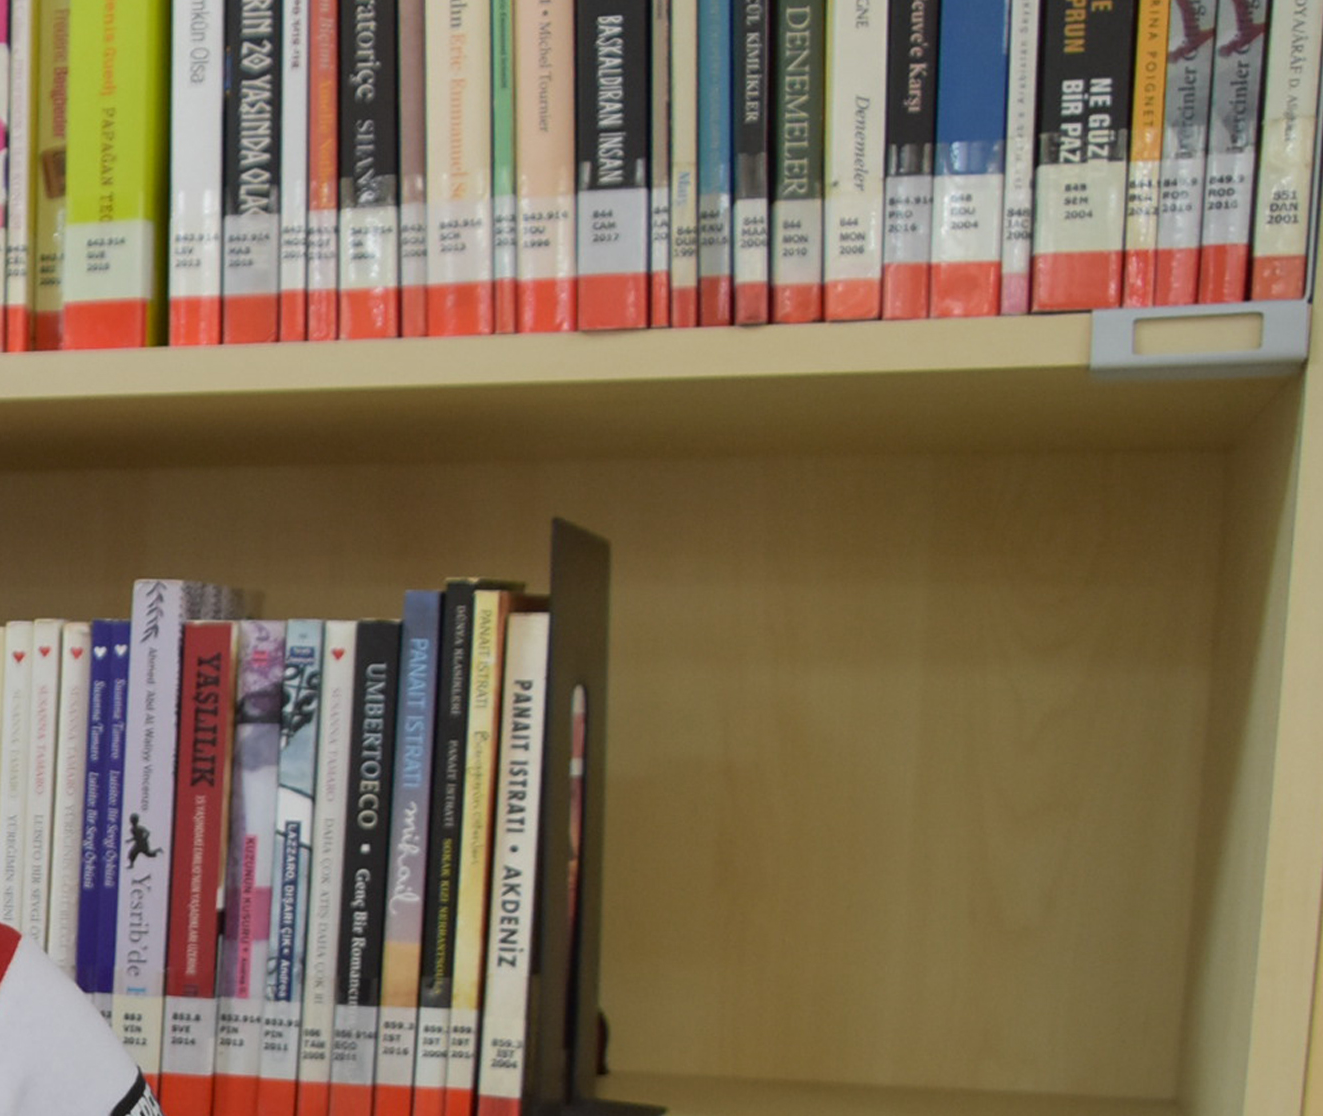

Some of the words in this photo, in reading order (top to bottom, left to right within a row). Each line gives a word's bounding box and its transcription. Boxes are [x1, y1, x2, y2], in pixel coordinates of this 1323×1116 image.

[240, 40, 274, 73] 20
[538, 21, 553, 68] Michel
[596, 15, 623, 129] BAŞKALDIRAN
[537, 71, 553, 133] Tournier
[745, 32, 762, 124] KİMLİKLER
[783, 6, 811, 197] DENEMELER
[904, 63, 928, 113] Karşı
[1061, 79, 1089, 116] BİR
[1090, 77, 1113, 108] NE
[239, 74, 272, 168] YAŞINDA
[853, 95, 871, 192] Denemeler
[597, 132, 626, 186] İNSAN
[1266, 215, 1299, 225] 2001
[1269, 202, 1299, 213] DAN
[92, 679, 106, 723] Susanna
[407, 639, 430, 709] PANAIT
[90, 724, 105, 762] Tamaro
[111, 722, 126, 760] Tamaro
[190, 652, 222, 788] YAŞLILIK
[511, 680, 534, 751] PANAIT
[402, 715, 426, 788] ISTRATI
[506, 760, 529, 834] ISTRATI
[351, 869, 371, 908] Genç
[497, 866, 524, 968] AKDENİZ
[126, 874, 152, 978] Yesrib'de
[352, 911, 369, 934] Bir
